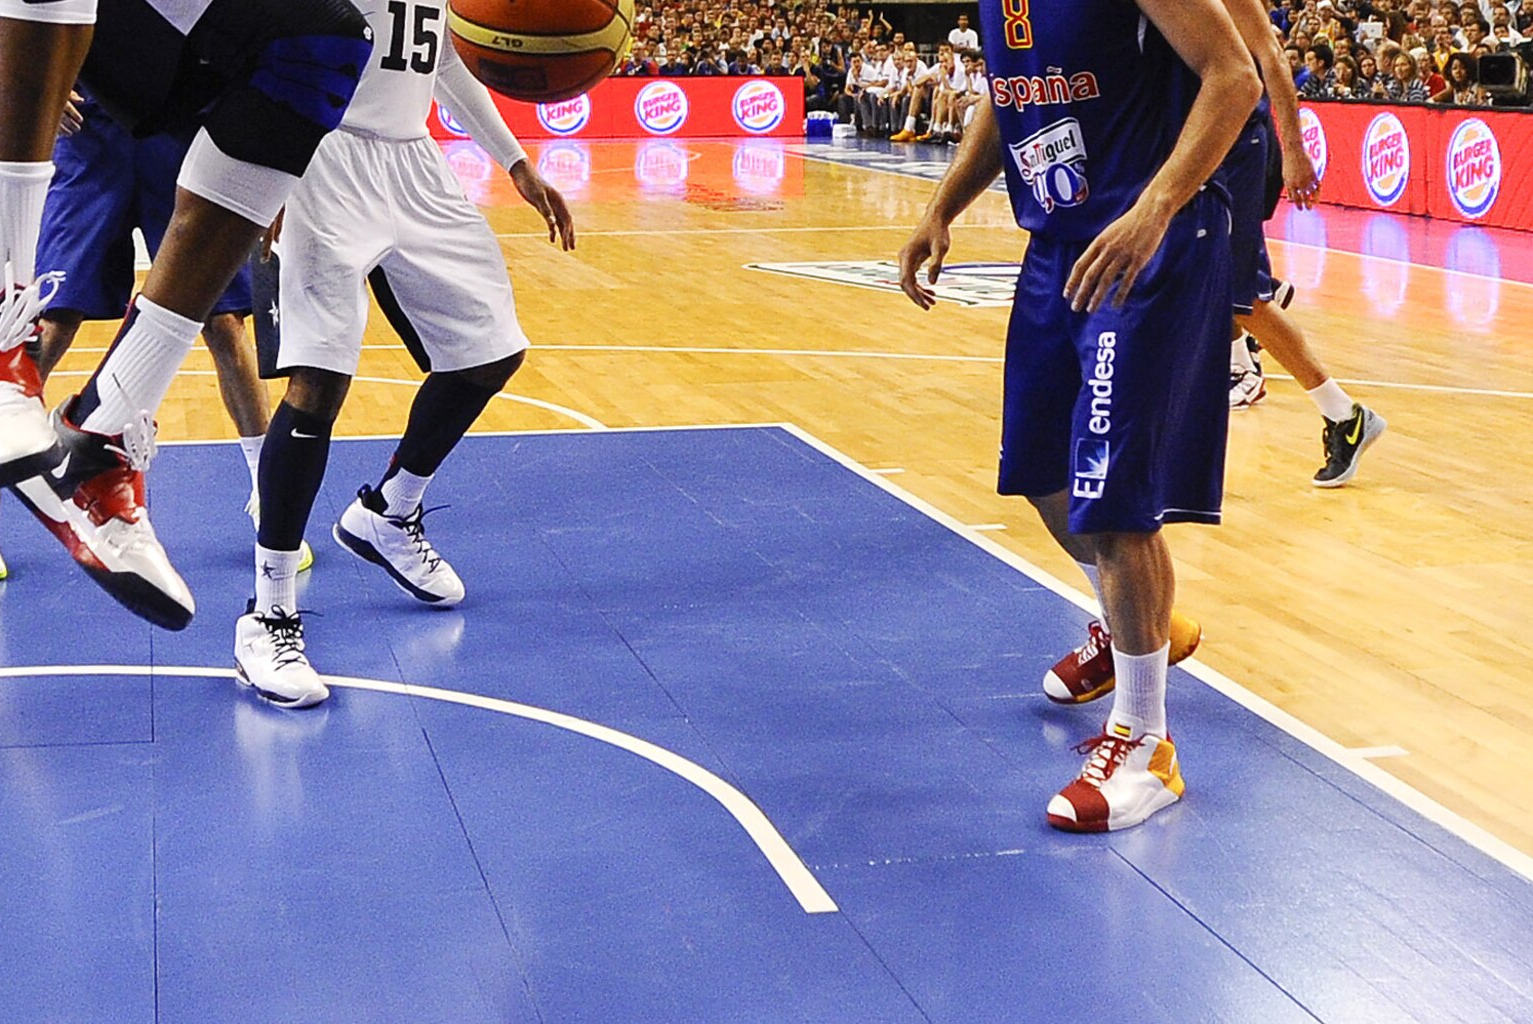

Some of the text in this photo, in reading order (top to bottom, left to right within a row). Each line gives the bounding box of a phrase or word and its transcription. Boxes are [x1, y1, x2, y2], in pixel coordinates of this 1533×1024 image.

[380, 0, 440, 75] 15
[991, 65, 1101, 113] spaña
[546, 100, 584, 122] KING
[644, 99, 682, 122] KING
[741, 99, 779, 122] KING
[1370, 149, 1404, 178] KING
[1454, 155, 1494, 190] KING
[1088, 331, 1117, 435] endesa
